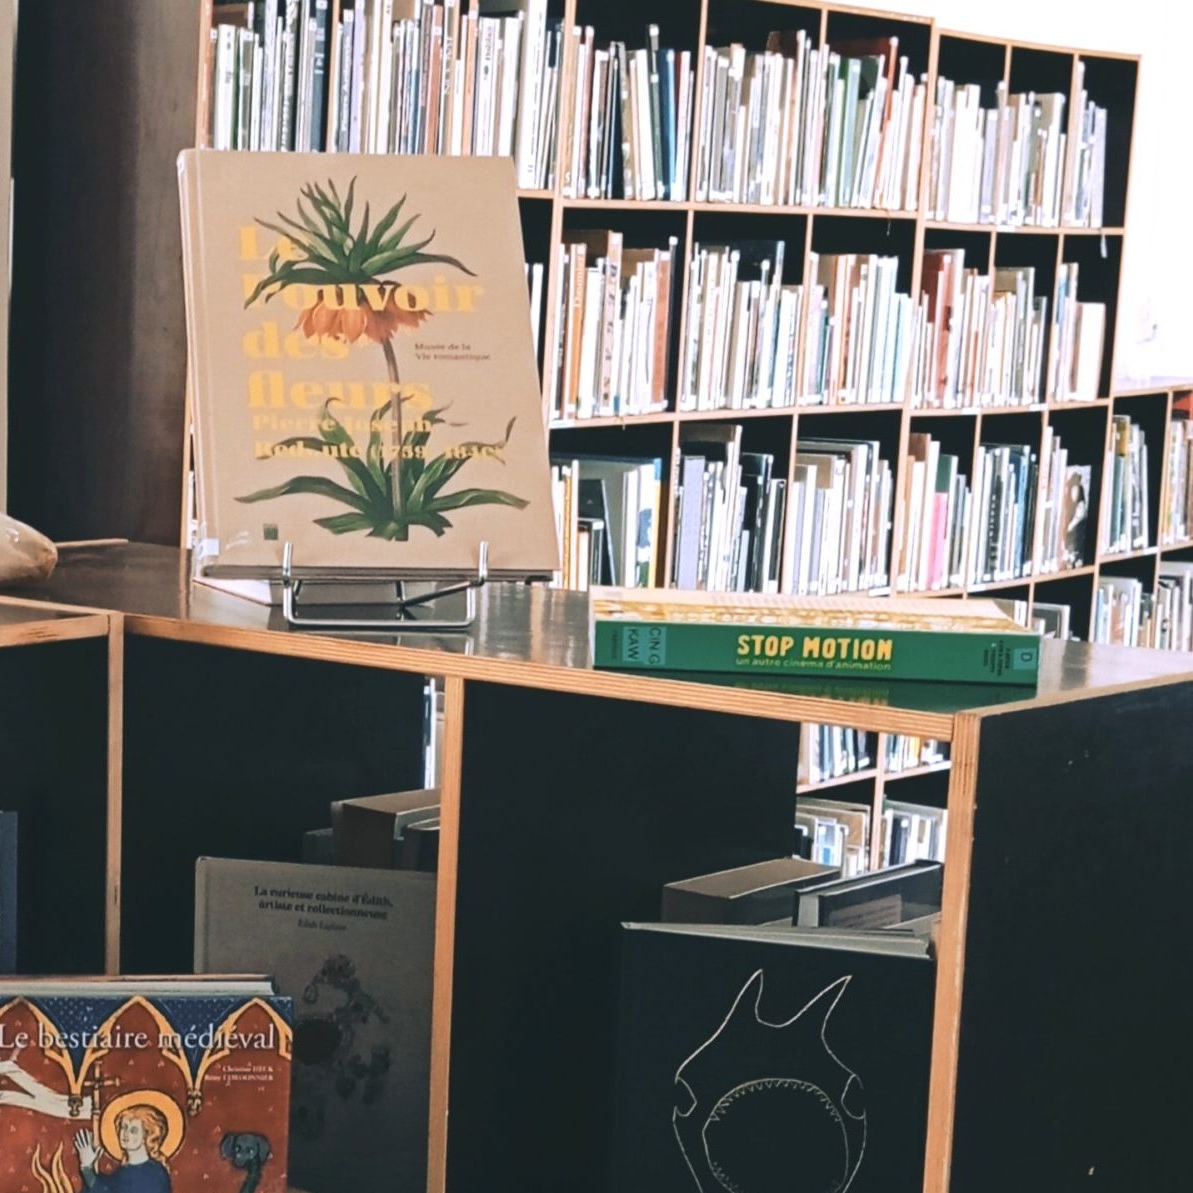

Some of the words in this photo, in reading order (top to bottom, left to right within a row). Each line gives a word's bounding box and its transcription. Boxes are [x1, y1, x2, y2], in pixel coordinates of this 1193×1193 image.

[239, 226, 306, 261] Le
[241, 273, 485, 312] Pouvoir
[243, 320, 351, 360] des
[248, 370, 434, 409] fleurs
[627, 628, 639, 660] KAW
[649, 626, 662, 650] CIN
[737, 634, 794, 657] STOP
[802, 636, 893, 661] MOTION
[752, 658, 781, 667] autre
[825, 660, 891, 671] d'animation
[254, 886, 268, 897] La
[294, 903, 306, 913] et
[38, 1022, 148, 1049] bestiaire
[158, 1022, 276, 1049] médiéval
